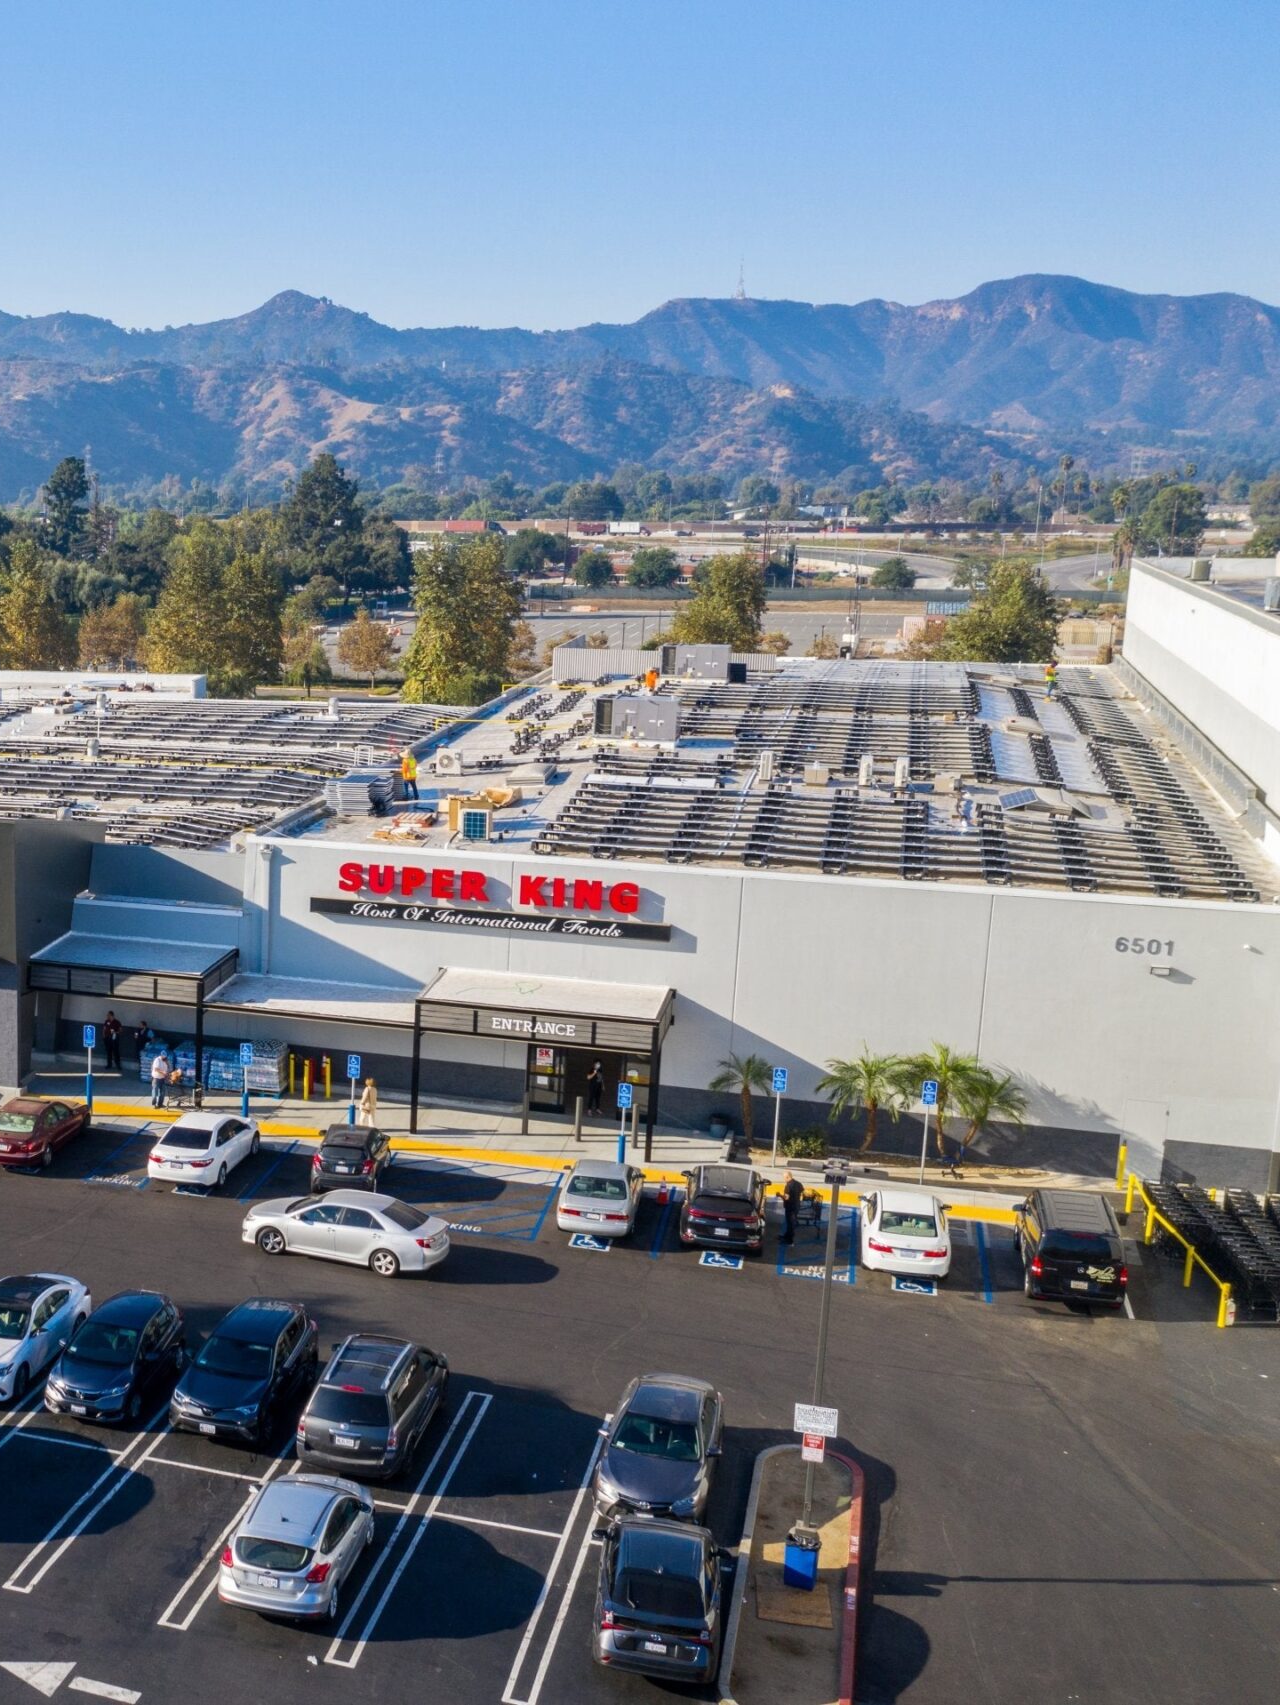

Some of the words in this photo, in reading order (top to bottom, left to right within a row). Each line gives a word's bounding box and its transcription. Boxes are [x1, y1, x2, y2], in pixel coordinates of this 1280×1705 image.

[338, 862, 490, 903] SUPER
[519, 874, 640, 914] KING
[350, 902, 397, 920] Host
[403, 905, 431, 921] Of
[431, 908, 558, 933] International
[562, 919, 624, 938] Foods
[1114, 936, 1175, 957] 6501
[491, 1017, 576, 1037] ENTRANCE
[449, 1223, 482, 1233] KING
